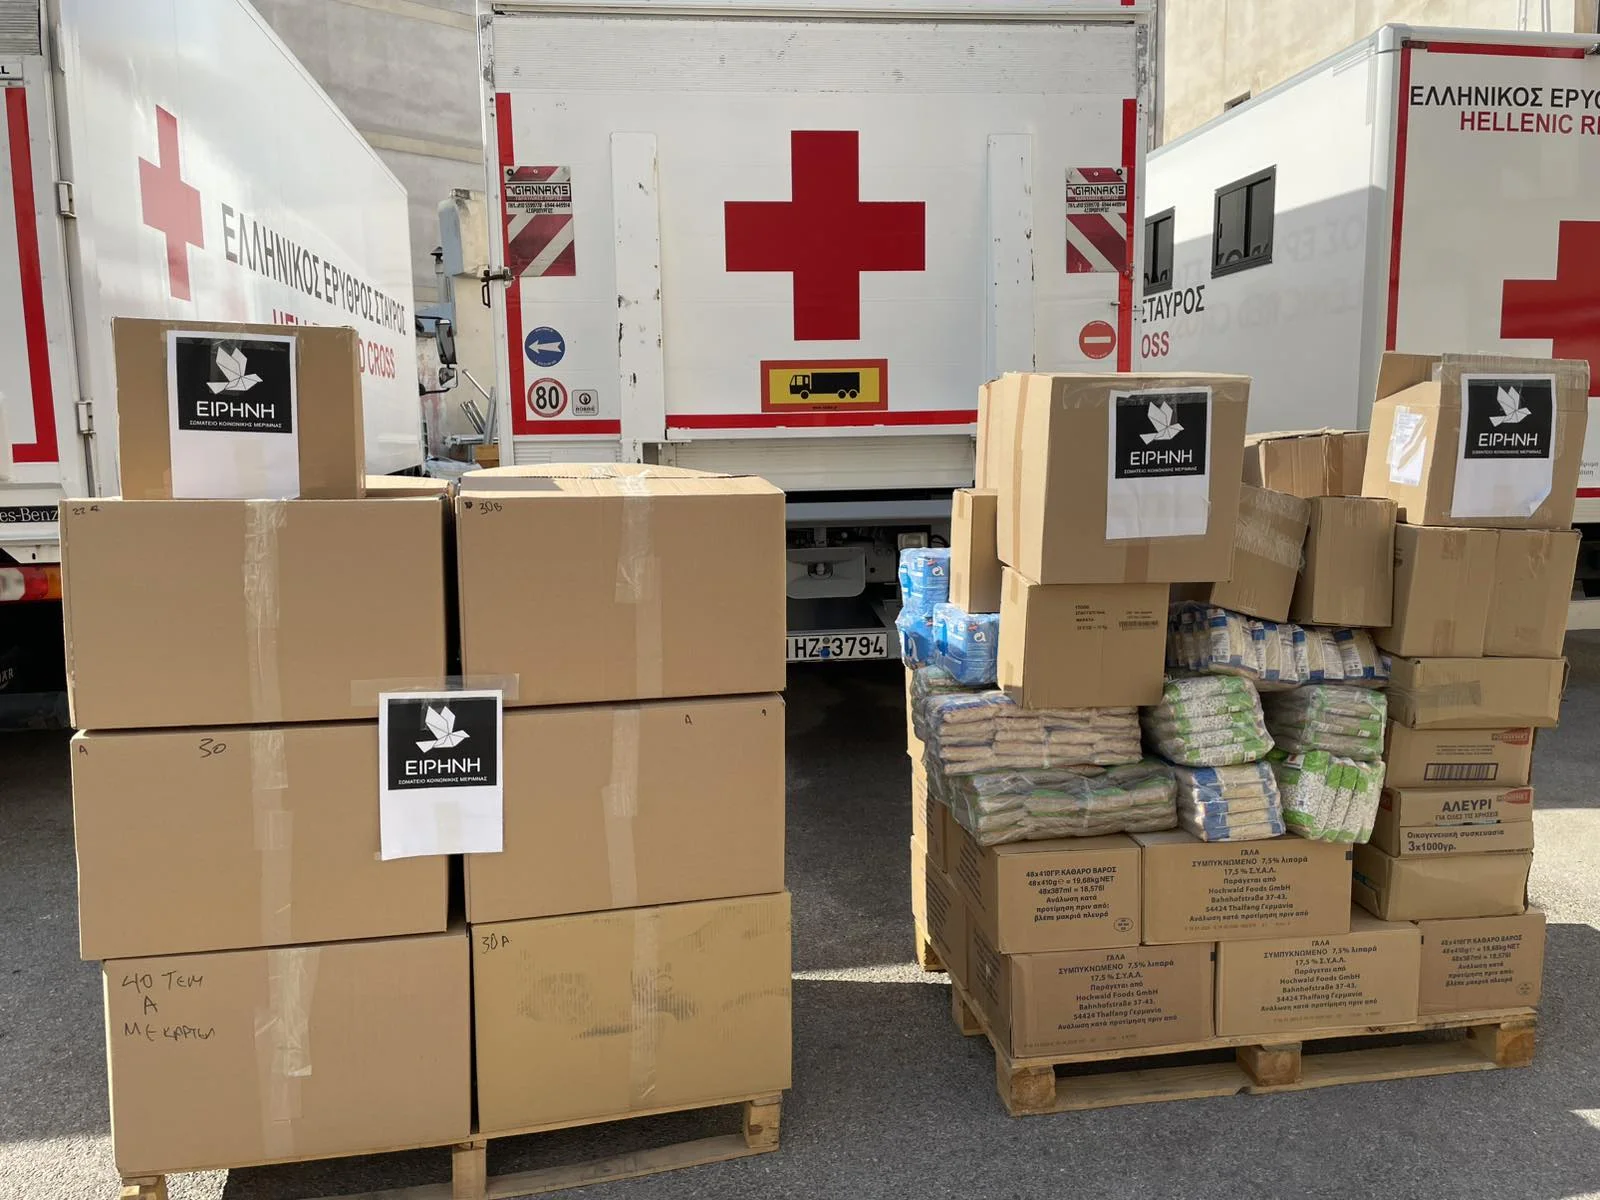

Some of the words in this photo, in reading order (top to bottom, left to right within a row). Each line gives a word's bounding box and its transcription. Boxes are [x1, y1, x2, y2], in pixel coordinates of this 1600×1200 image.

[1410, 86, 1543, 107] ΕΛΛΗΝΙΚΟΣ
[1460, 111, 1573, 134] HELLENIC
[221, 202, 322, 299] ΕΛΛΗΝΙΚΟΣ
[323, 261, 374, 322] ΕΡΥΘΡΟΣ
[375, 289, 406, 336] ΣΤΑΥΡΟΣ
[367, 341, 396, 379] CROSS
[536, 386, 560, 410] 80
[197, 401, 274, 418] ΕΙΡΗΝΗ
[1478, 433, 1538, 446] ΕΙΡΗΝΗ
[1130, 449, 1192, 465] ΕΙΡΗΝΗ
[0, 508, 58, 522] es-Benz
[198, 738, 226, 758] 30
[406, 758, 480, 775] ΕΙΡΗΝΗ
[1442, 799, 1492, 812] ΑΛΕΥΡΙ
[1192, 858, 1257, 867] ΣΥΜΠΥΚΝΩΜΕΝΟ
[122, 972, 153, 993] 40
